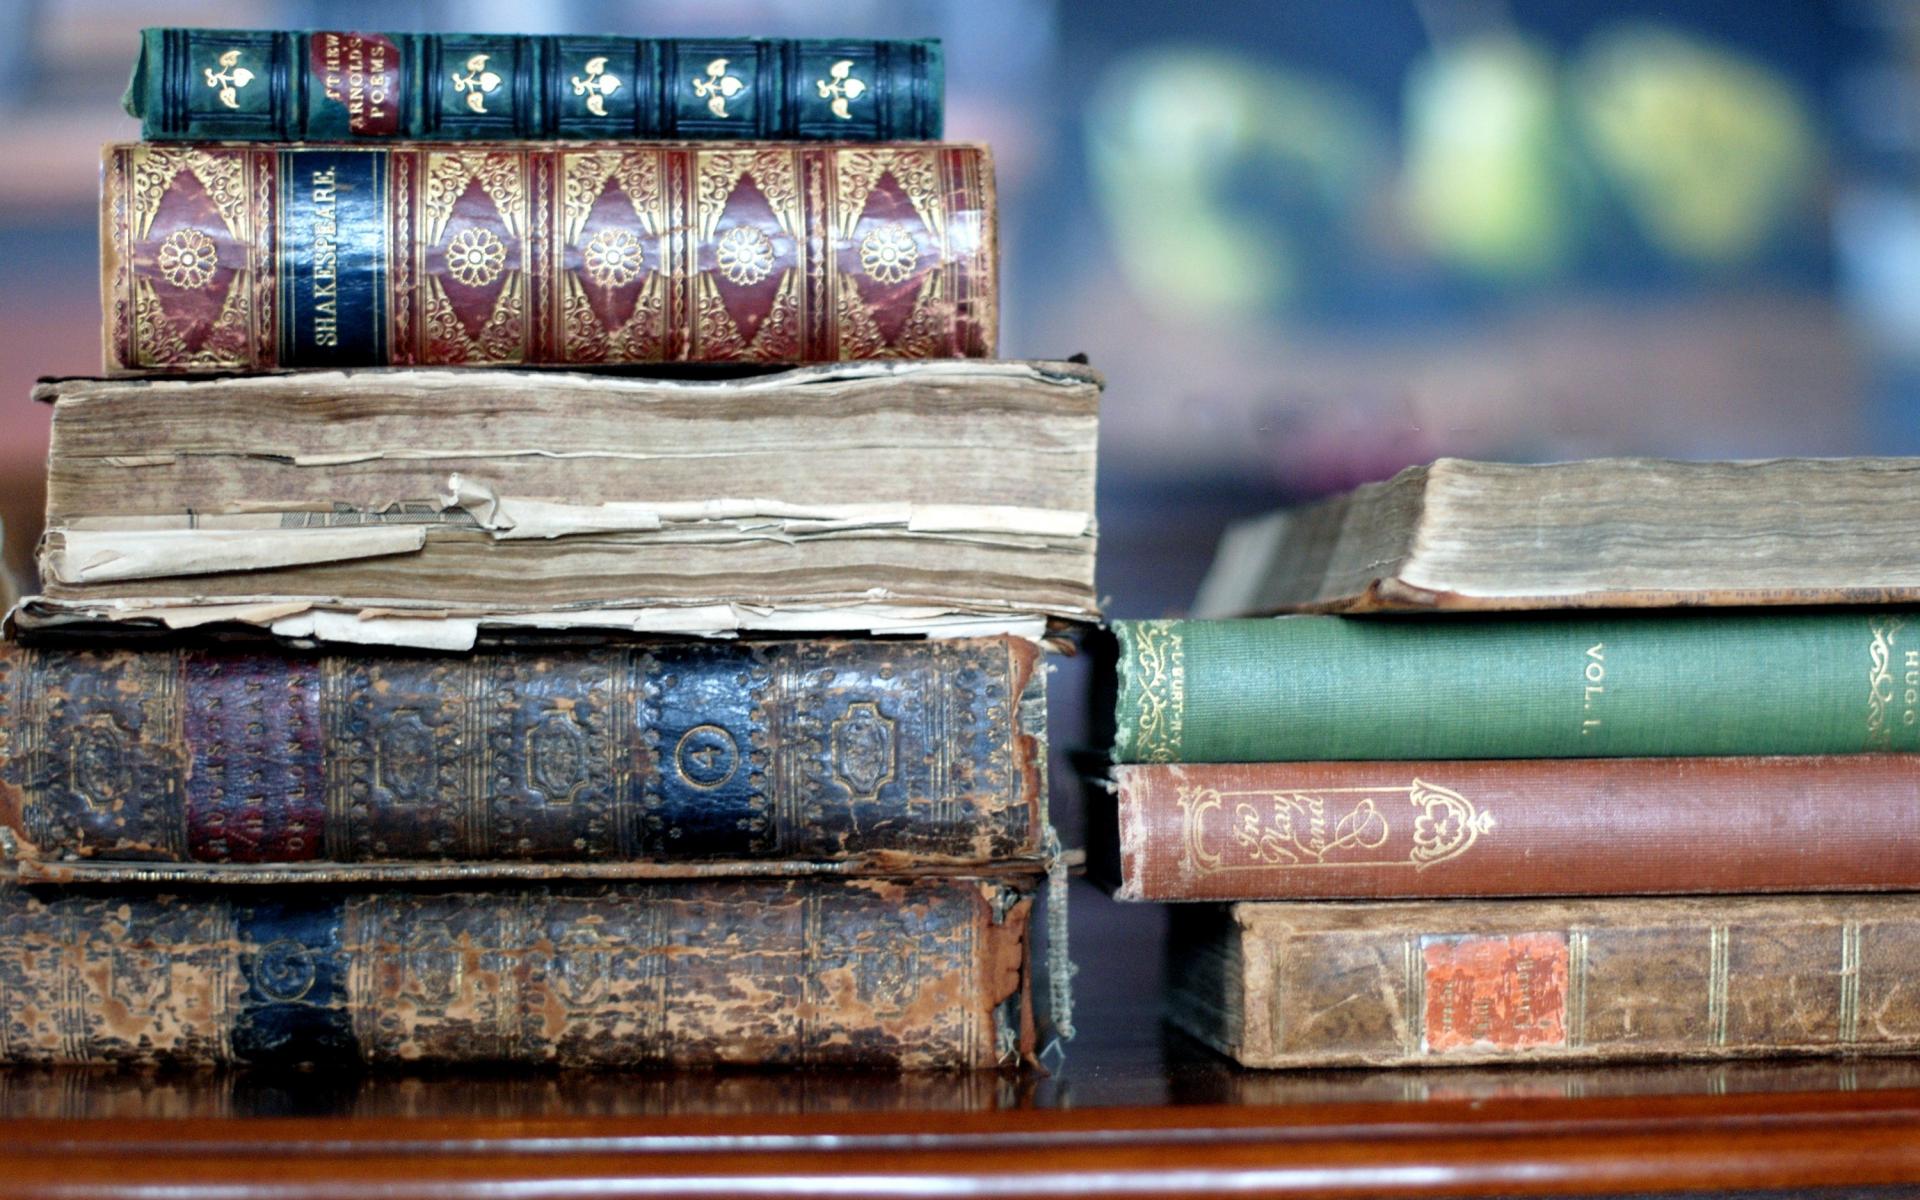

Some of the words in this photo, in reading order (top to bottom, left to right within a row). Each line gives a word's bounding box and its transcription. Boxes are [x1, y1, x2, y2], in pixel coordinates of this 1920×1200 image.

[325, 34, 341, 102] TTHEW
[343, 37, 364, 129] ARNOLD'S
[369, 40, 385, 119] POEMS.
[312, 166, 338, 347] SHAKESPEARE.
[1583, 642, 1604, 710] VOL.
[1903, 650, 1919, 726] HUGO
[1232, 802, 1260, 859] In
[1260, 794, 1304, 864] Play
